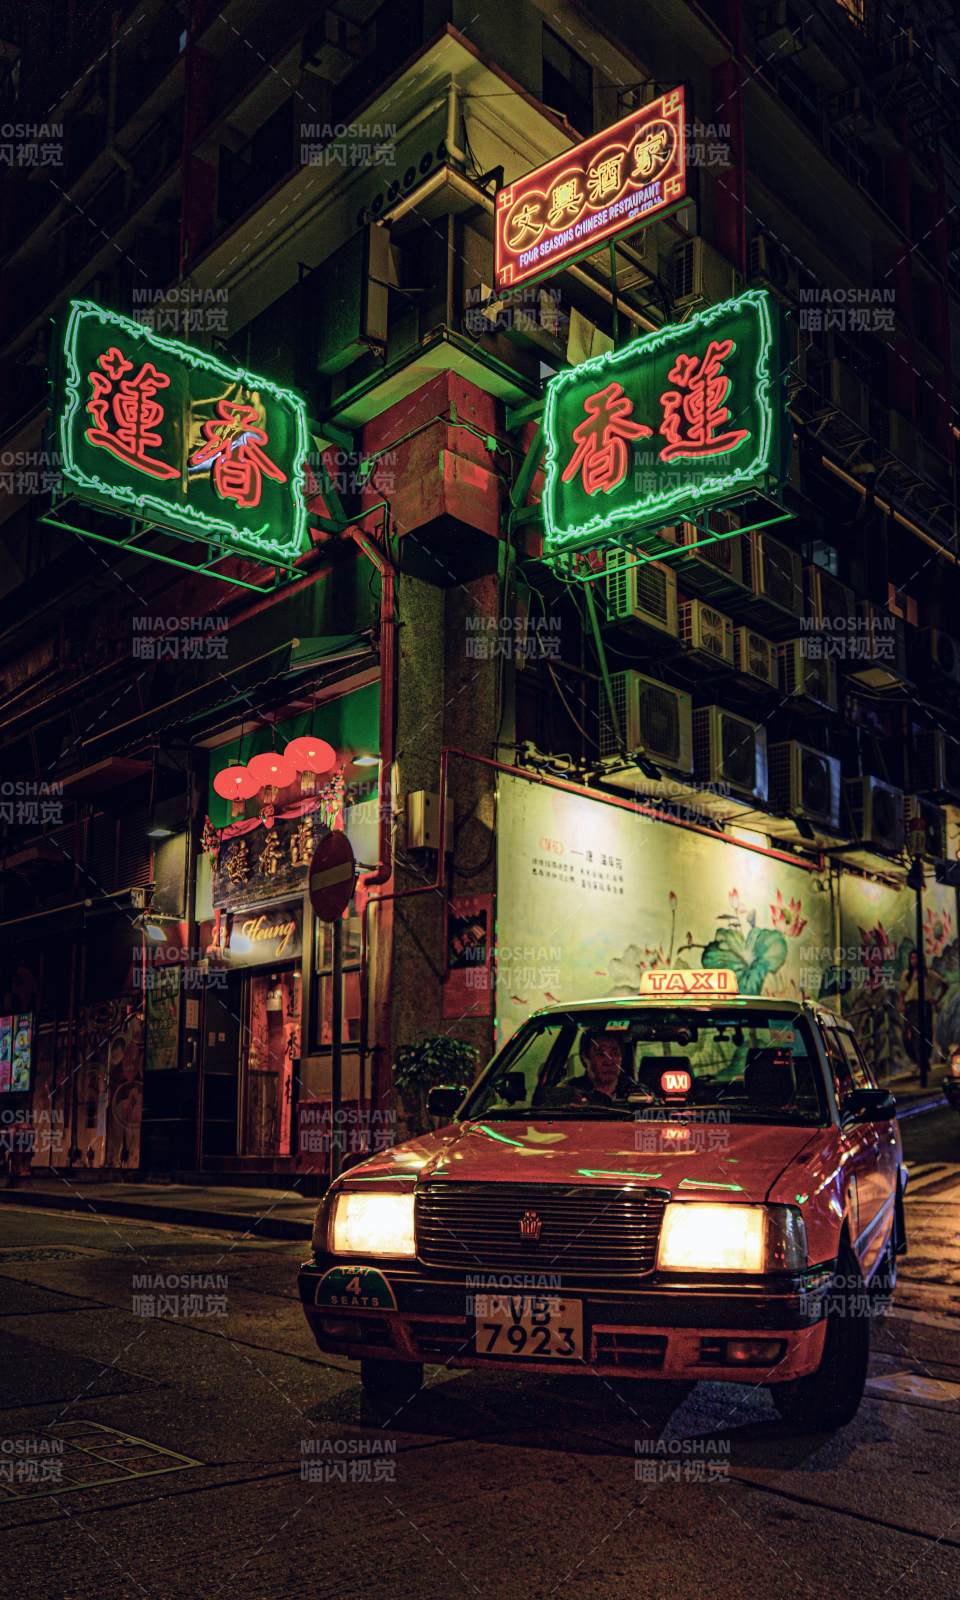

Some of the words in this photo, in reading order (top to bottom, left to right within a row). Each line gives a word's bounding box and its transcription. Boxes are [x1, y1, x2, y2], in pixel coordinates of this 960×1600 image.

[519, 247, 540, 268] FOUR
[539, 228, 574, 257] SEASONS
[575, 209, 609, 238] CHINESE
[608, 180, 661, 221] RESTAURANT
[242, 914, 296, 957] Heung
[646, 971, 728, 992] TAXI
[664, 1073, 689, 1090] TAXI
[344, 1276, 362, 1295] 4
[328, 1295, 382, 1307] SEATS
[509, 1296, 551, 1326] VB
[482, 1323, 576, 1356] 7923
